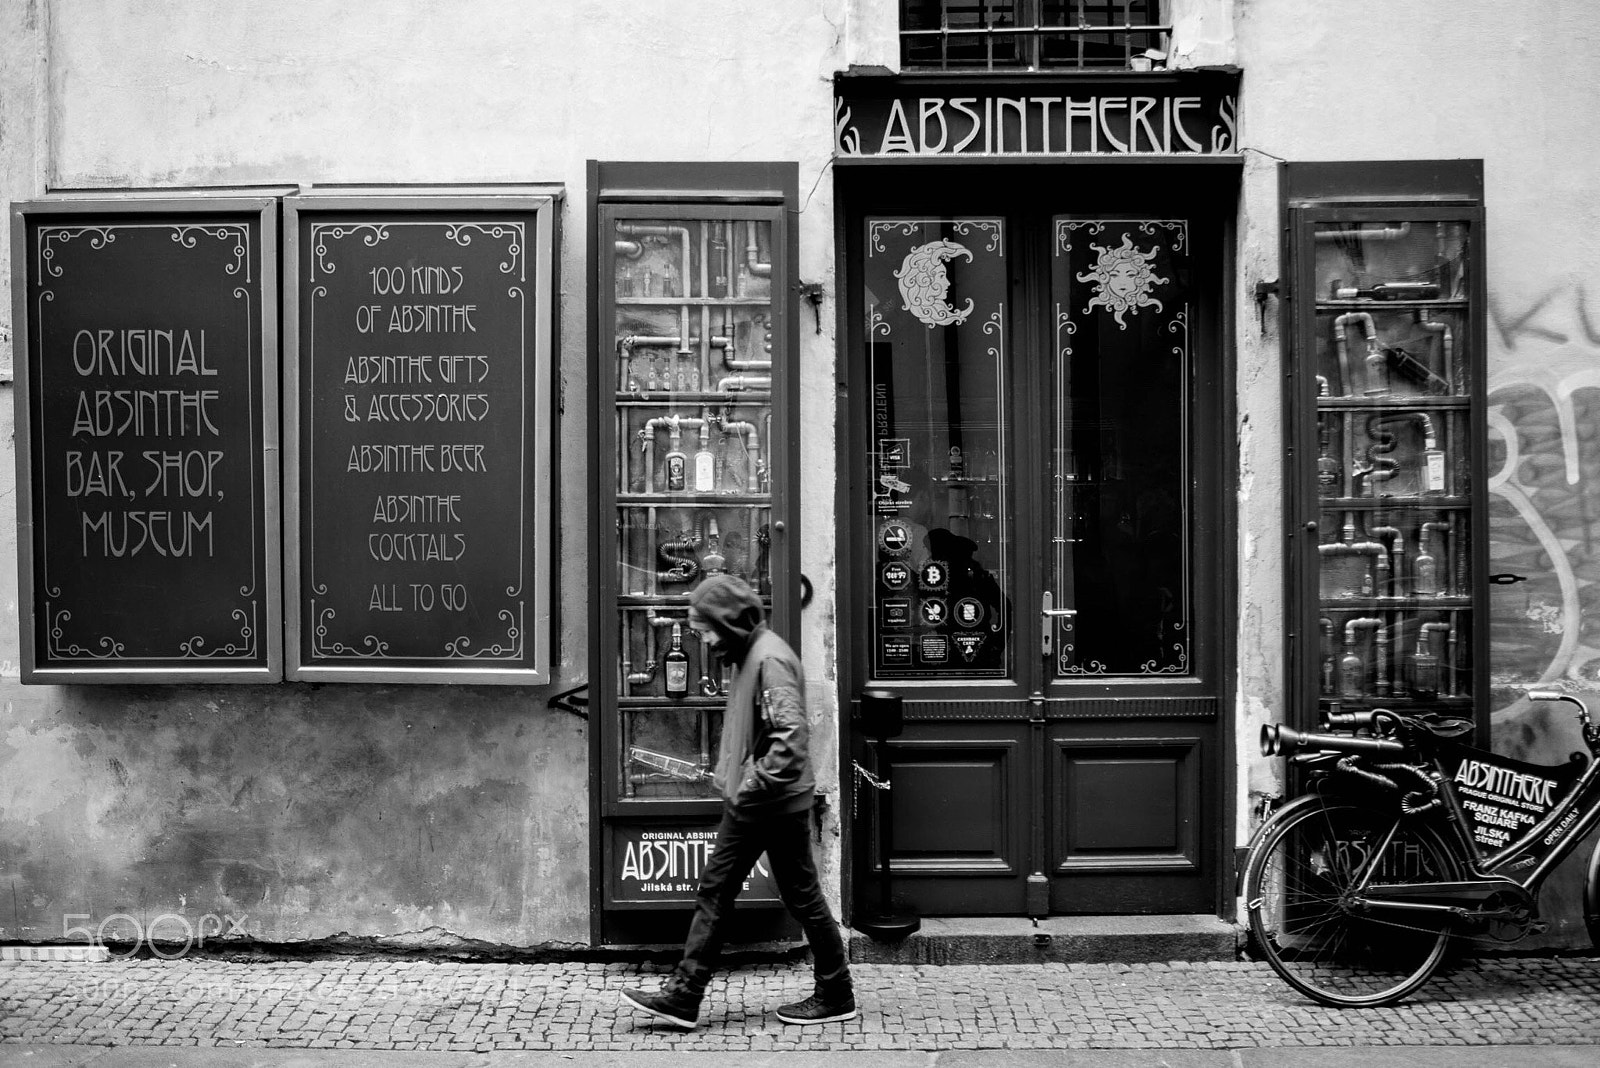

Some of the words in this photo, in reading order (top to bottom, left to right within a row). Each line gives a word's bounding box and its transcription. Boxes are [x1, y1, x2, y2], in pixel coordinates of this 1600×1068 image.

[878, 94, 1204, 152] ABSINTHERIE
[369, 267, 405, 294] 100
[412, 267, 463, 294] KINDS
[357, 306, 381, 333] OF
[389, 305, 476, 332] ABSINTHE
[74, 330, 217, 375] ORIGINAL
[345, 356, 432, 383] ABSINTHE
[439, 356, 488, 383] GIFTS
[73, 390, 219, 436] ABSINTHE
[345, 395, 360, 421] &
[368, 394, 489, 421] ACCESSORIES
[348, 445, 434, 472] ABSINTHE
[441, 445, 486, 472] BEER
[67, 451, 135, 501] BAR,
[143, 450, 223, 501] SHOP,
[374, 496, 460, 522] ABSINTHE
[83, 512, 212, 557] MUSEUM
[369, 534, 465, 561] COCKTAILS
[369, 584, 402, 611] ALL
[410, 584, 434, 611] TO
[441, 584, 466, 611] GO
[1454, 758, 1558, 807] ABSINTHERIE
[1458, 786, 1488, 799] PRAGUE
[1487, 794, 1520, 807] ORIGINAL
[1520, 802, 1545, 813] STORE
[1463, 800, 1499, 817] FRANZ
[1500, 809, 1536, 825] KAFKA
[1474, 812, 1519, 830] SQUARE
[1474, 825, 1511, 842] JILSKA
[1543, 825, 1564, 846] OPEN
[1560, 807, 1580, 828] DAILY
[1474, 835, 1504, 848] street
[641, 883, 672, 891] Jilská
[676, 884, 694, 892] str.
